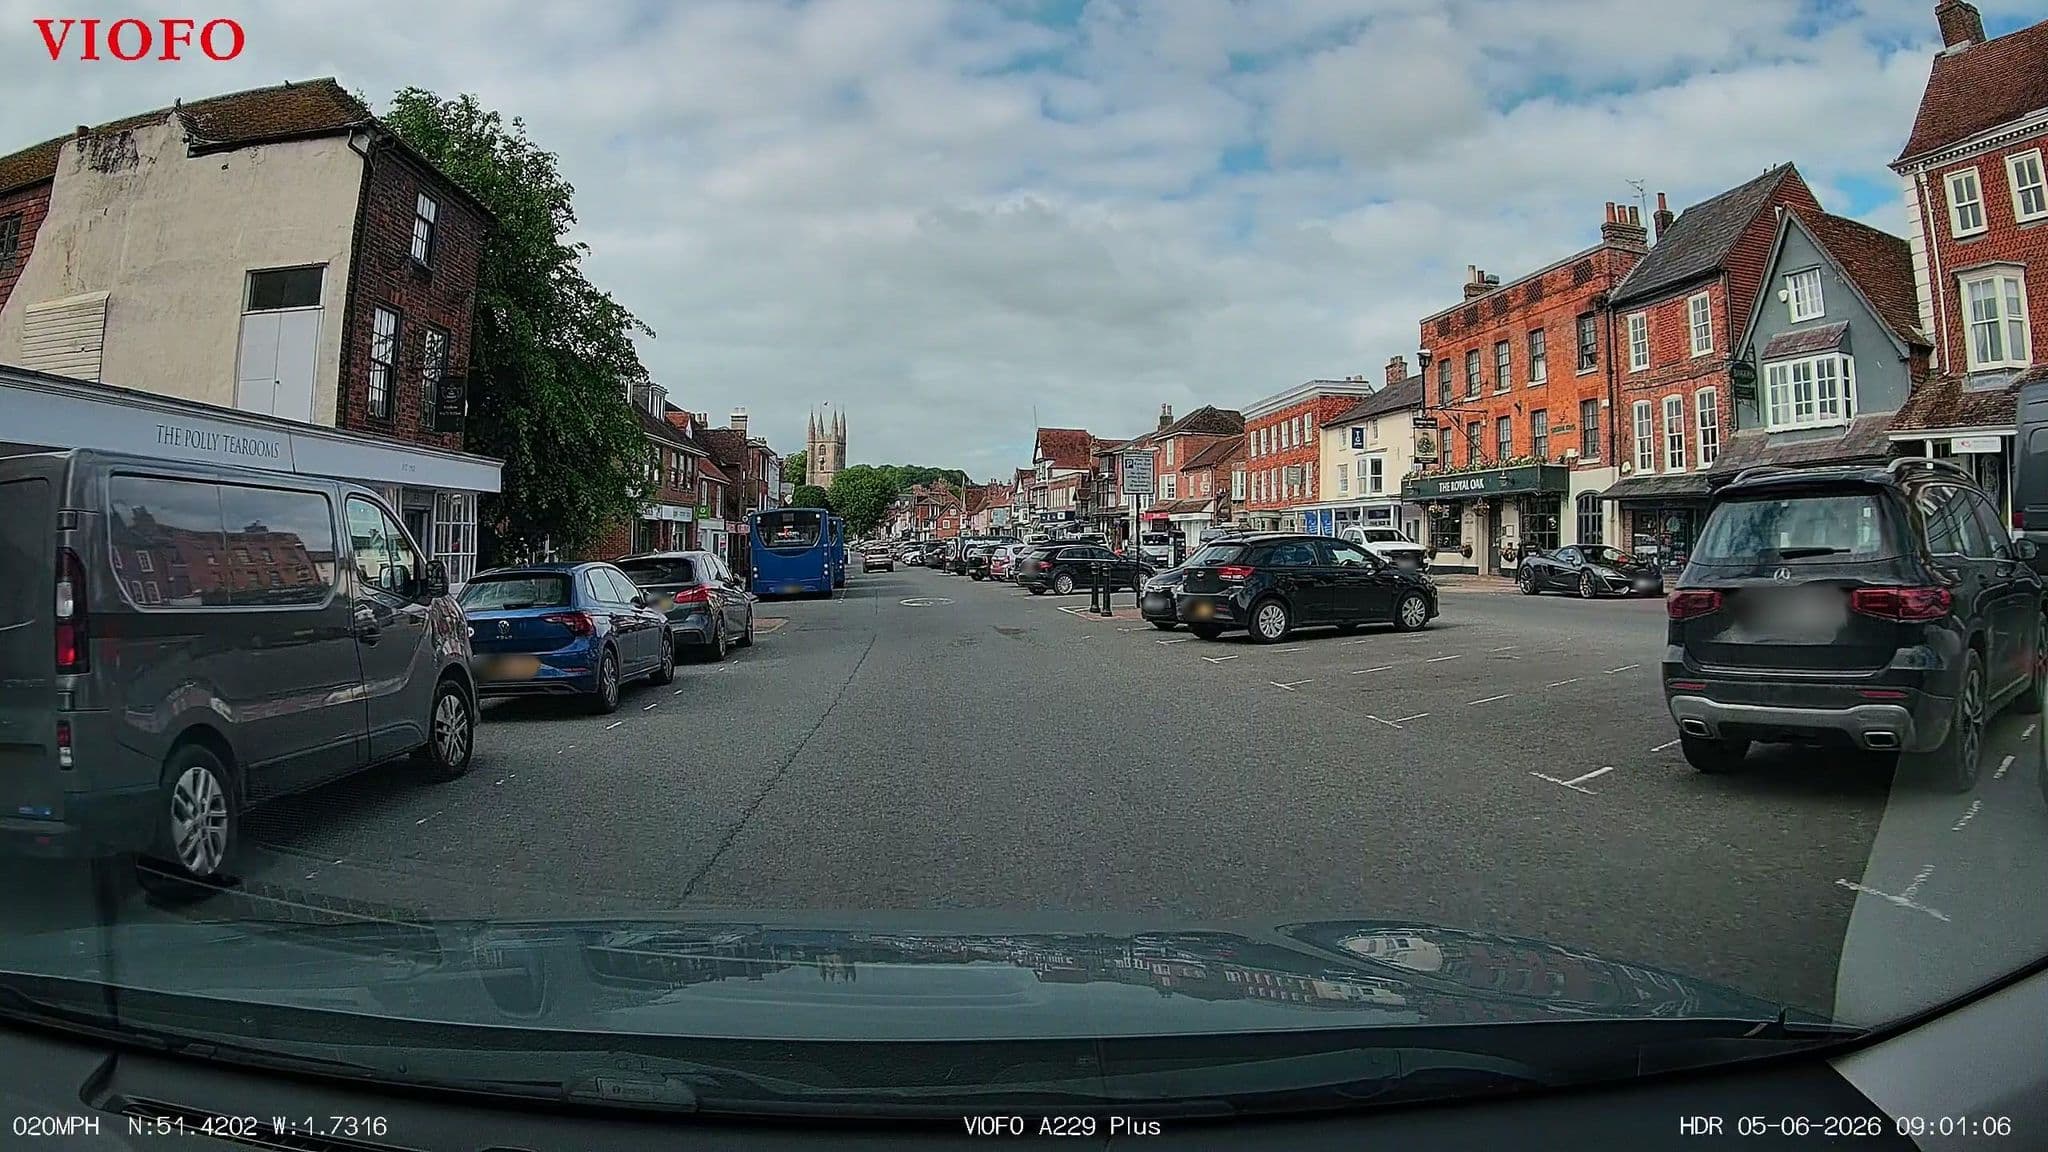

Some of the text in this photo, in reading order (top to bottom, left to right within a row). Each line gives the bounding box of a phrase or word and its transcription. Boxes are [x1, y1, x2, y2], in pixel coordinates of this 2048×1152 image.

[156, 424, 280, 458] THE POLLY TEAROOMS
[1438, 478, 1485, 493] THE ROYAL OAK
